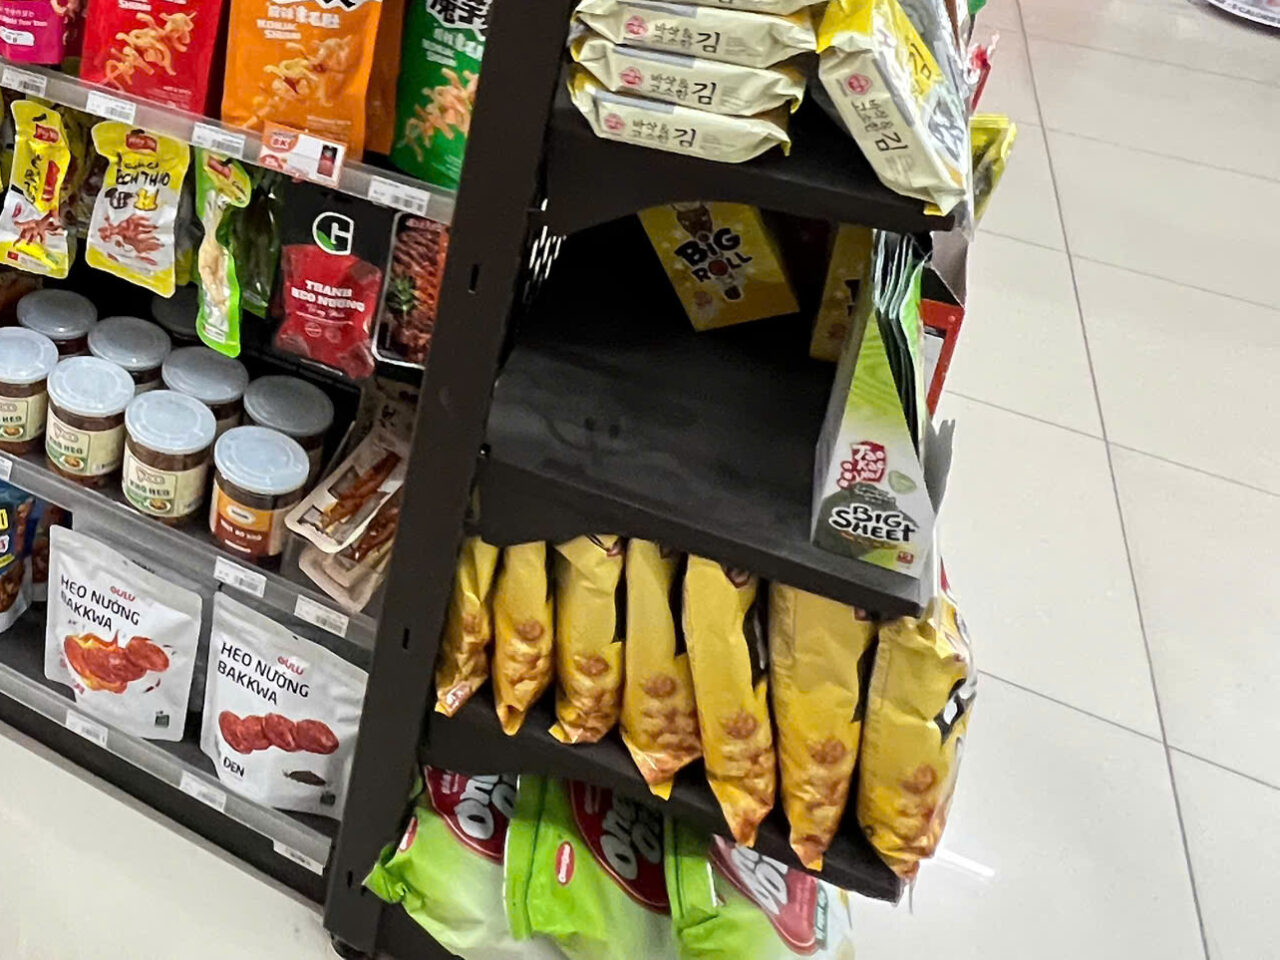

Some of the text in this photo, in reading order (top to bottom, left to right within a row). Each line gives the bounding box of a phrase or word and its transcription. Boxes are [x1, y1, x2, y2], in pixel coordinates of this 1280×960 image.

[695, 31, 721, 54] 김
[691, 81, 718, 106] 김
[672, 127, 697, 148] 김
[874, 131, 909, 152] 김
[674, 227, 742, 266] BIG
[829, 507, 918, 543] SHEET
[851, 503, 903, 529] BIG
[60, 573, 141, 626] HEO NƯỚNG
[60, 590, 113, 632] BAKKWA
[217, 660, 279, 706] BAKKWA
[220, 642, 311, 698] HEO NƯỚNG
